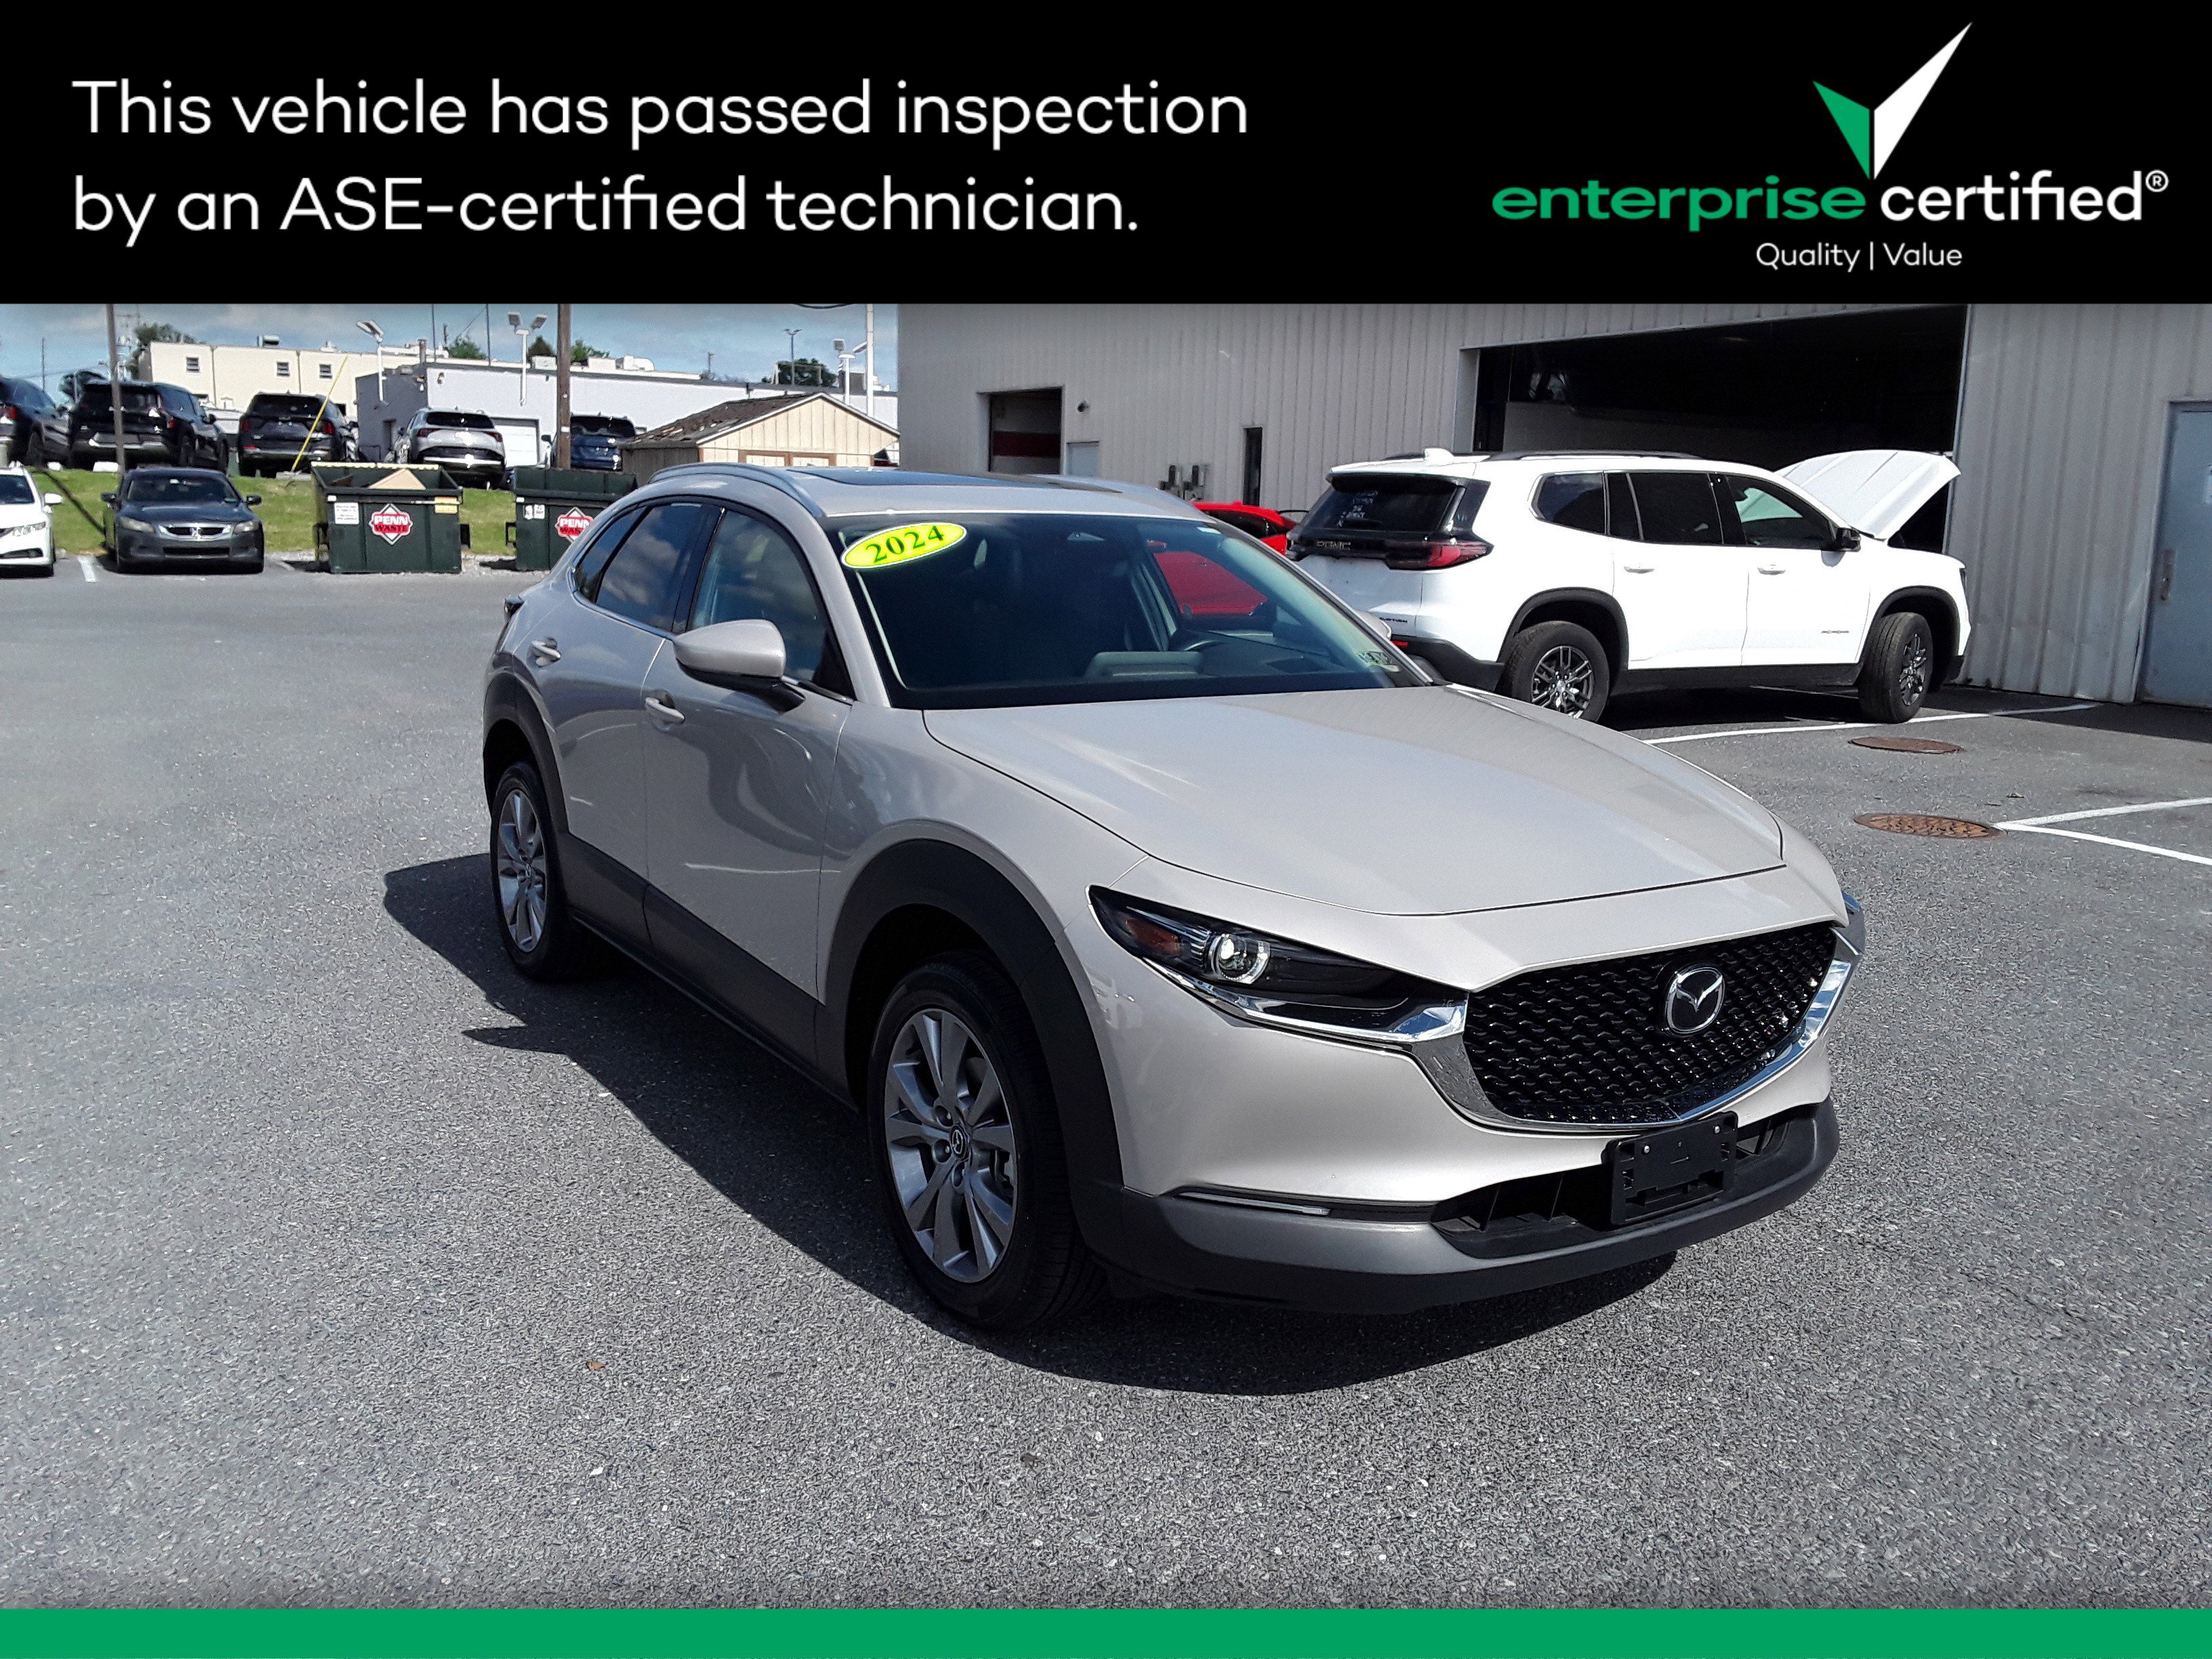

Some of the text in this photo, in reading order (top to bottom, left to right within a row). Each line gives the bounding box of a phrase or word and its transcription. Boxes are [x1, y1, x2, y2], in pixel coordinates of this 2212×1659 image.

[374, 515, 409, 525] PENN
[374, 523, 409, 533] WASTE
[865, 525, 944, 563] 2024
